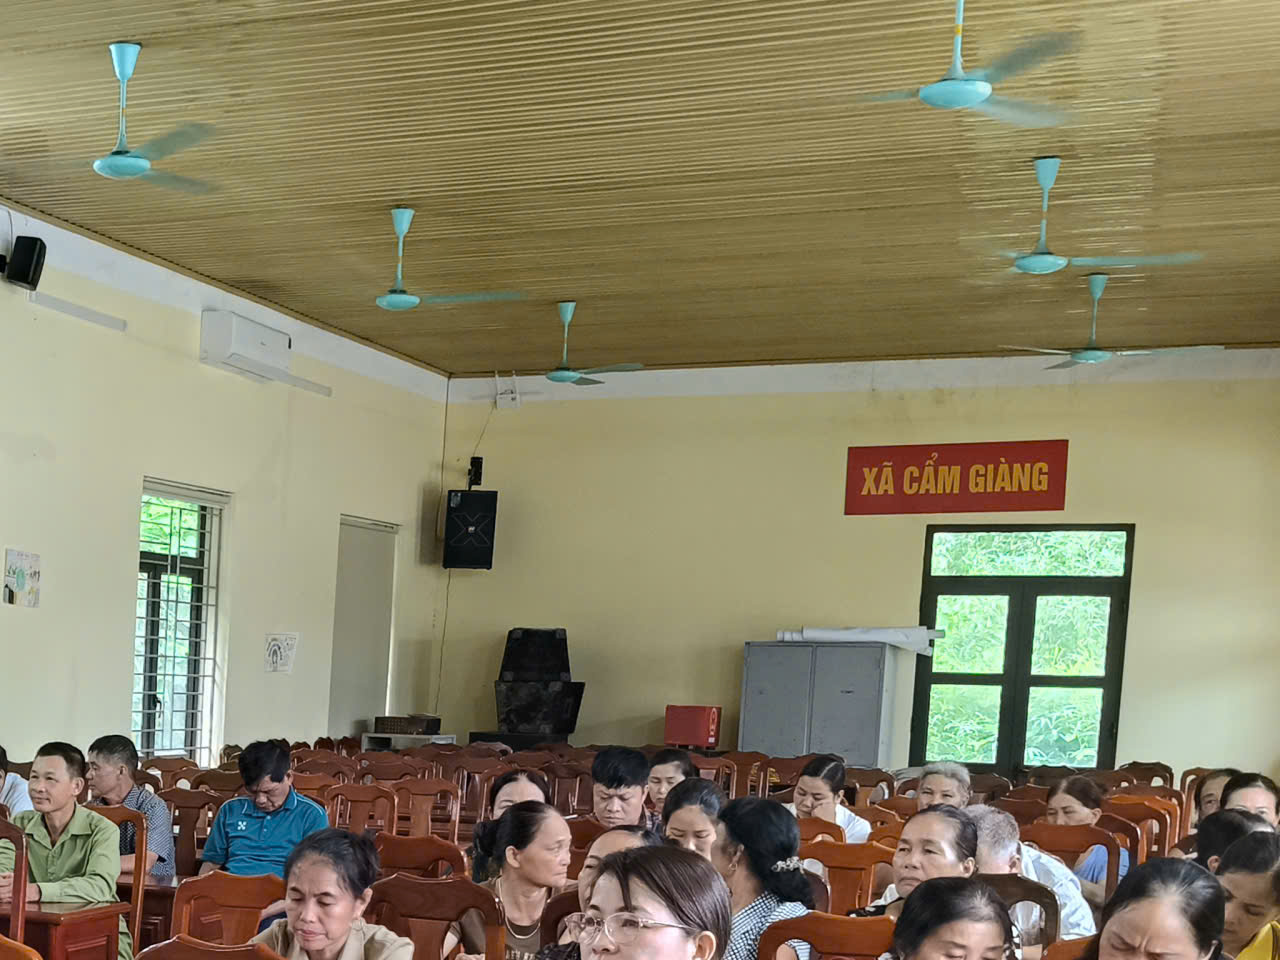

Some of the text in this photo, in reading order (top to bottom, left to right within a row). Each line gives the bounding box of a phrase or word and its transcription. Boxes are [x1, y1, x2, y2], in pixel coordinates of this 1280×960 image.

[861, 452, 1050, 496] XÃ CẨM GIÀNG
